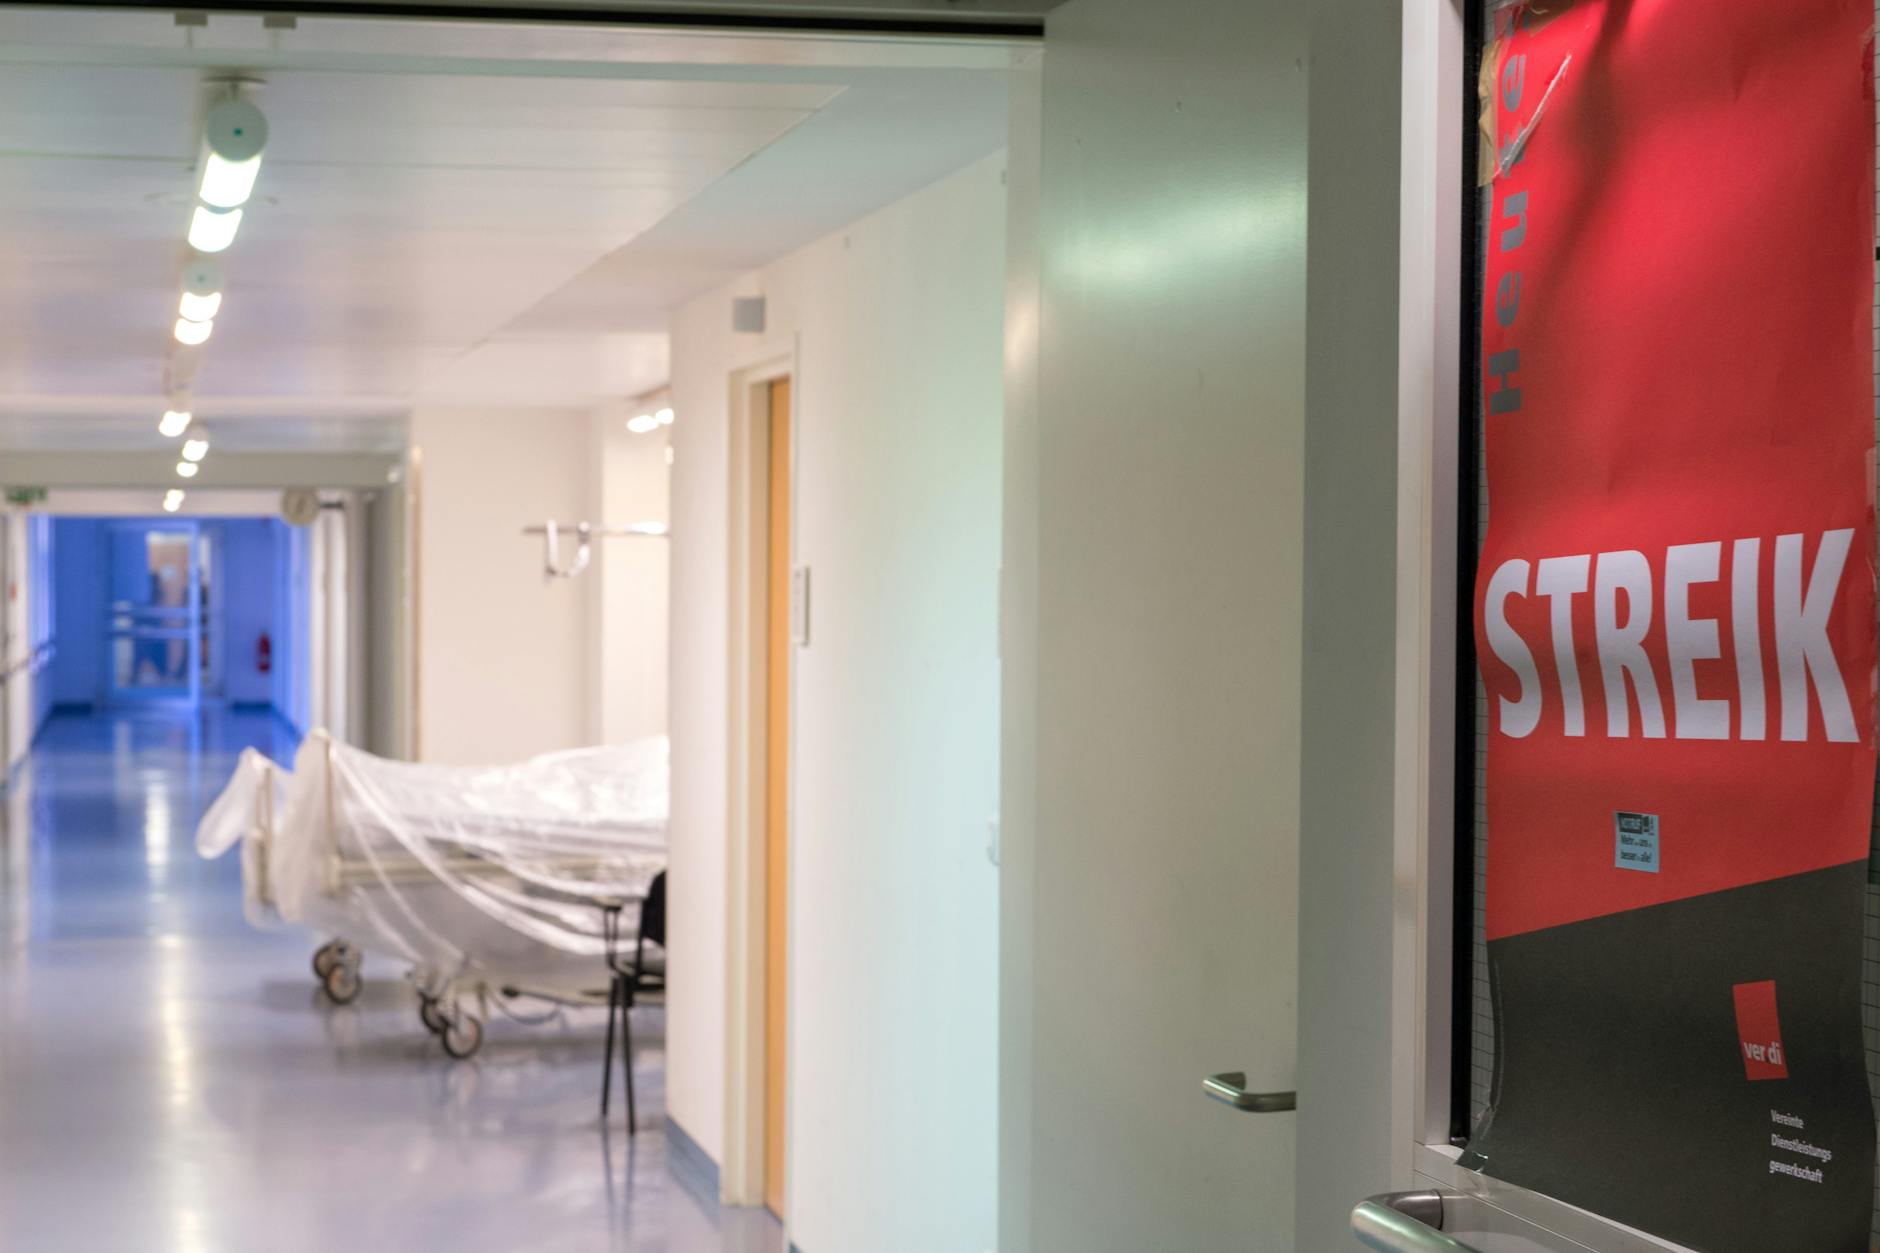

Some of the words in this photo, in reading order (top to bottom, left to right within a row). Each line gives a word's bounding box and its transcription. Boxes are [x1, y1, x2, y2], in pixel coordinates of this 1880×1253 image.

[1485, 528, 1860, 743] STREIK
[1770, 1109, 1804, 1129] Vereinte
[1770, 1133, 1832, 1163] Dienstleistungs
[1769, 1159, 1823, 1184] gewerkschaft
